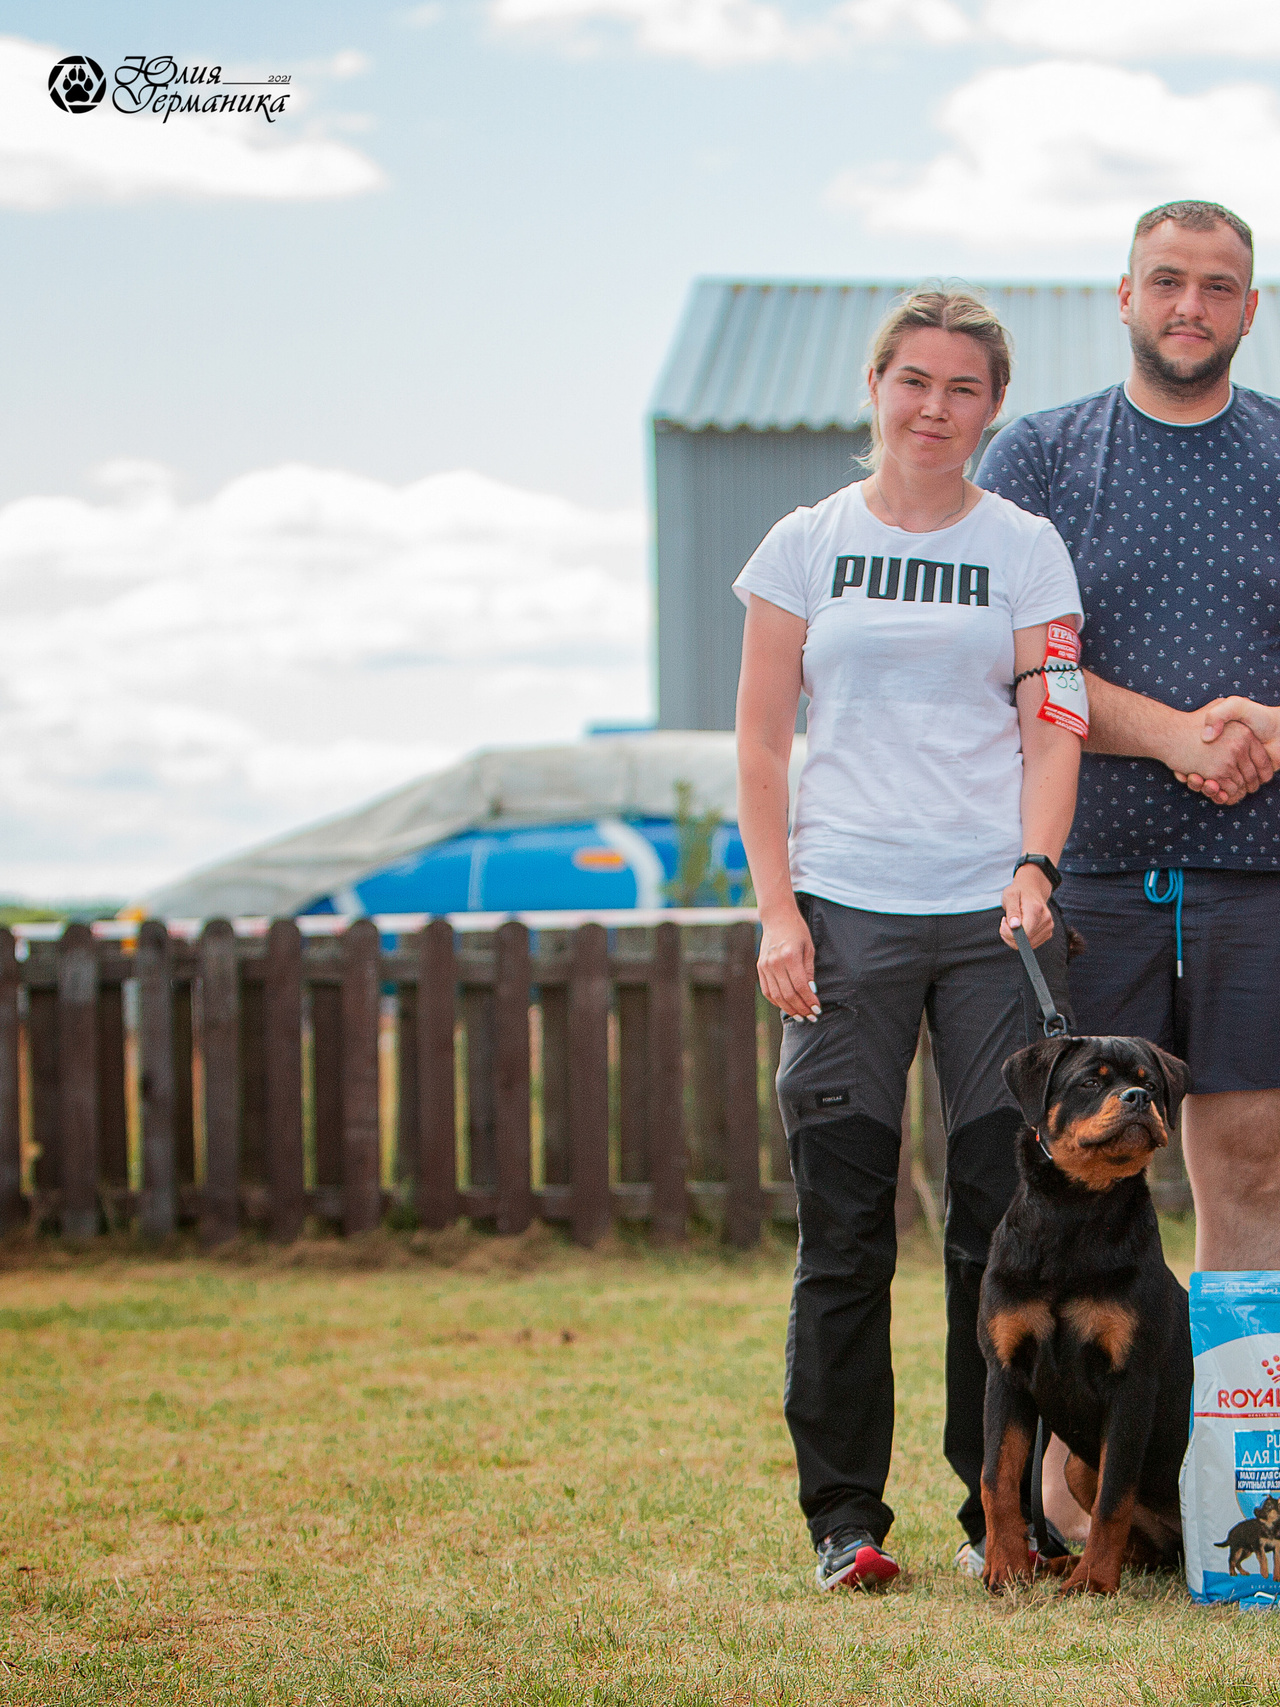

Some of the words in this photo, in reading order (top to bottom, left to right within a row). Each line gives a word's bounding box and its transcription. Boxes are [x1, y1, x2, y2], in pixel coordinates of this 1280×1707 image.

[831, 555, 989, 607] PUMA
[1056, 671, 1079, 692] 33
[1241, 1450, 1270, 1466] ДЛЯ
[1237, 1481, 1267, 1490] КРУПНЫХ
